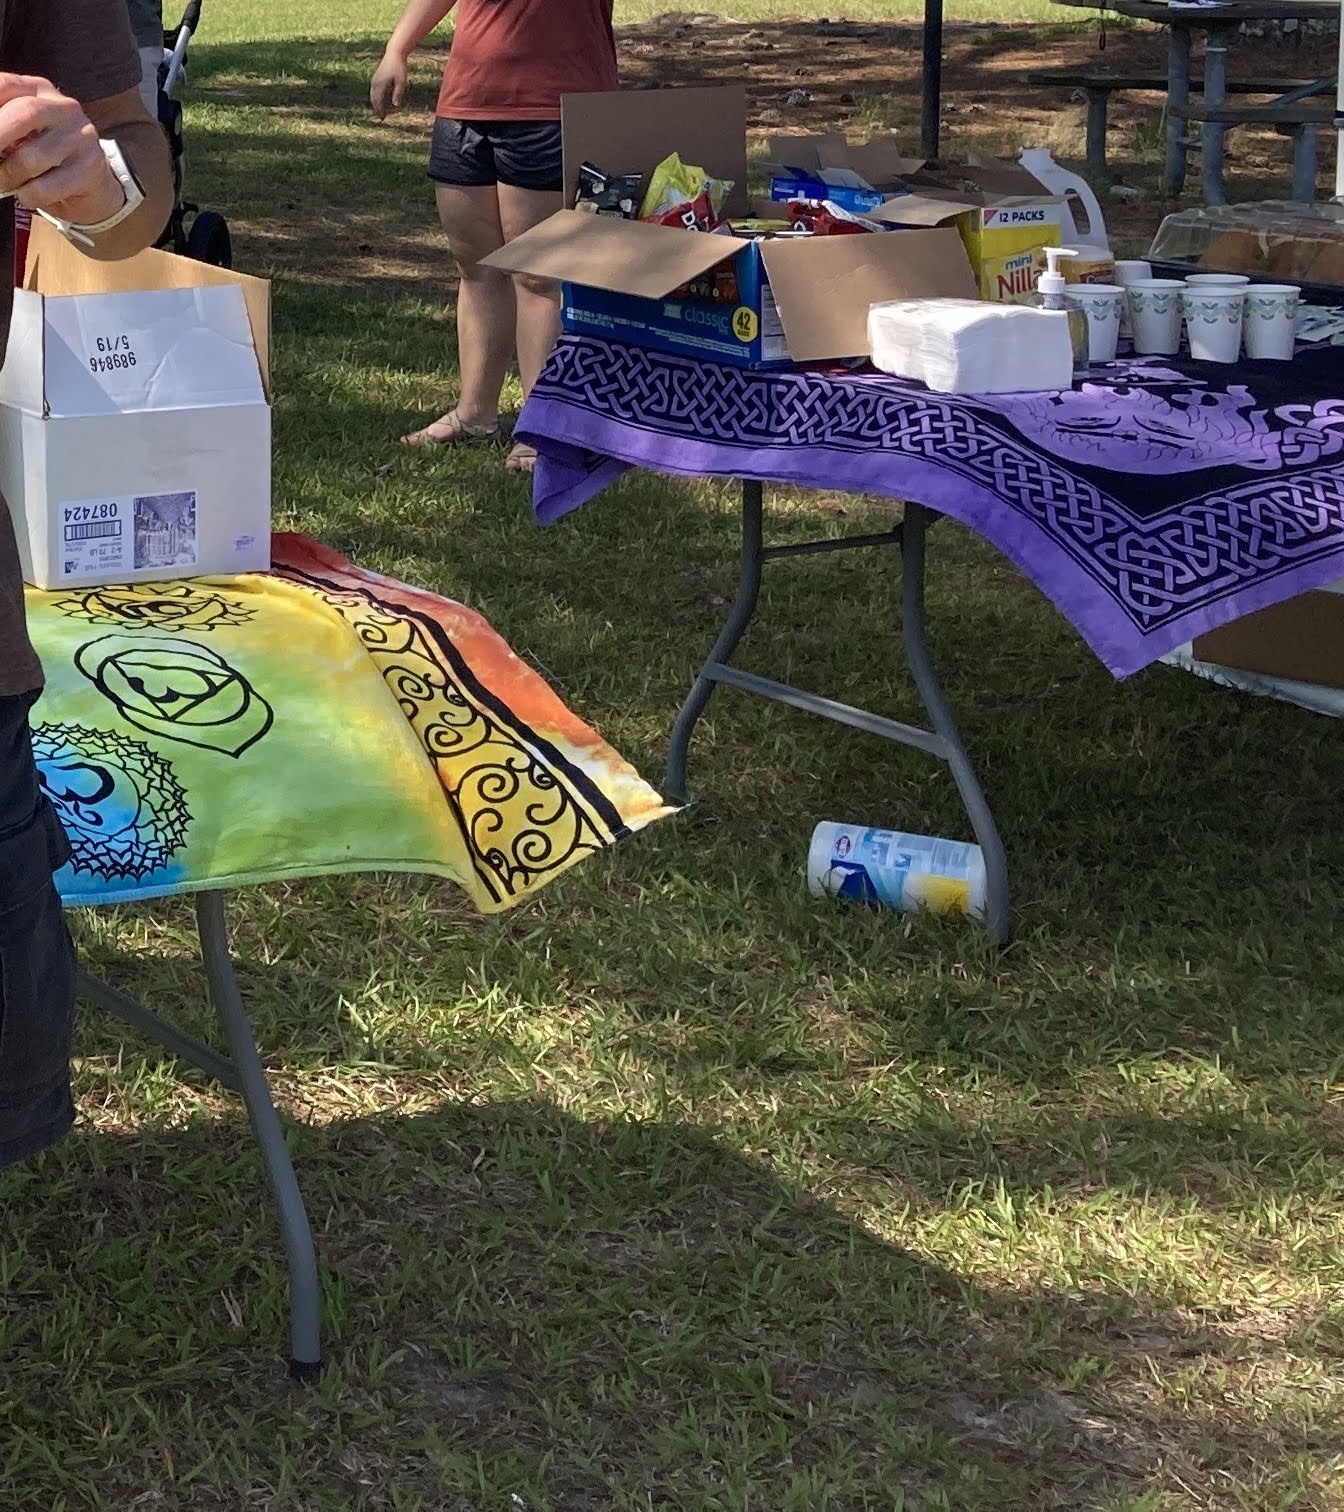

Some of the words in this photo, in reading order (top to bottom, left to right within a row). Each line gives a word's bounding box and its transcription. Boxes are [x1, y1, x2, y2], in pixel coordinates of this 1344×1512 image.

[999, 211, 1009, 223] 12
[1012, 210, 1045, 222] PACKS
[1005, 253, 1033, 270] mini
[684, 306, 730, 328] classic
[736, 311, 751, 330] 42
[96, 335, 130, 352] 5/19
[89, 351, 137, 372] 989846
[64, 503, 118, 522] 087424
